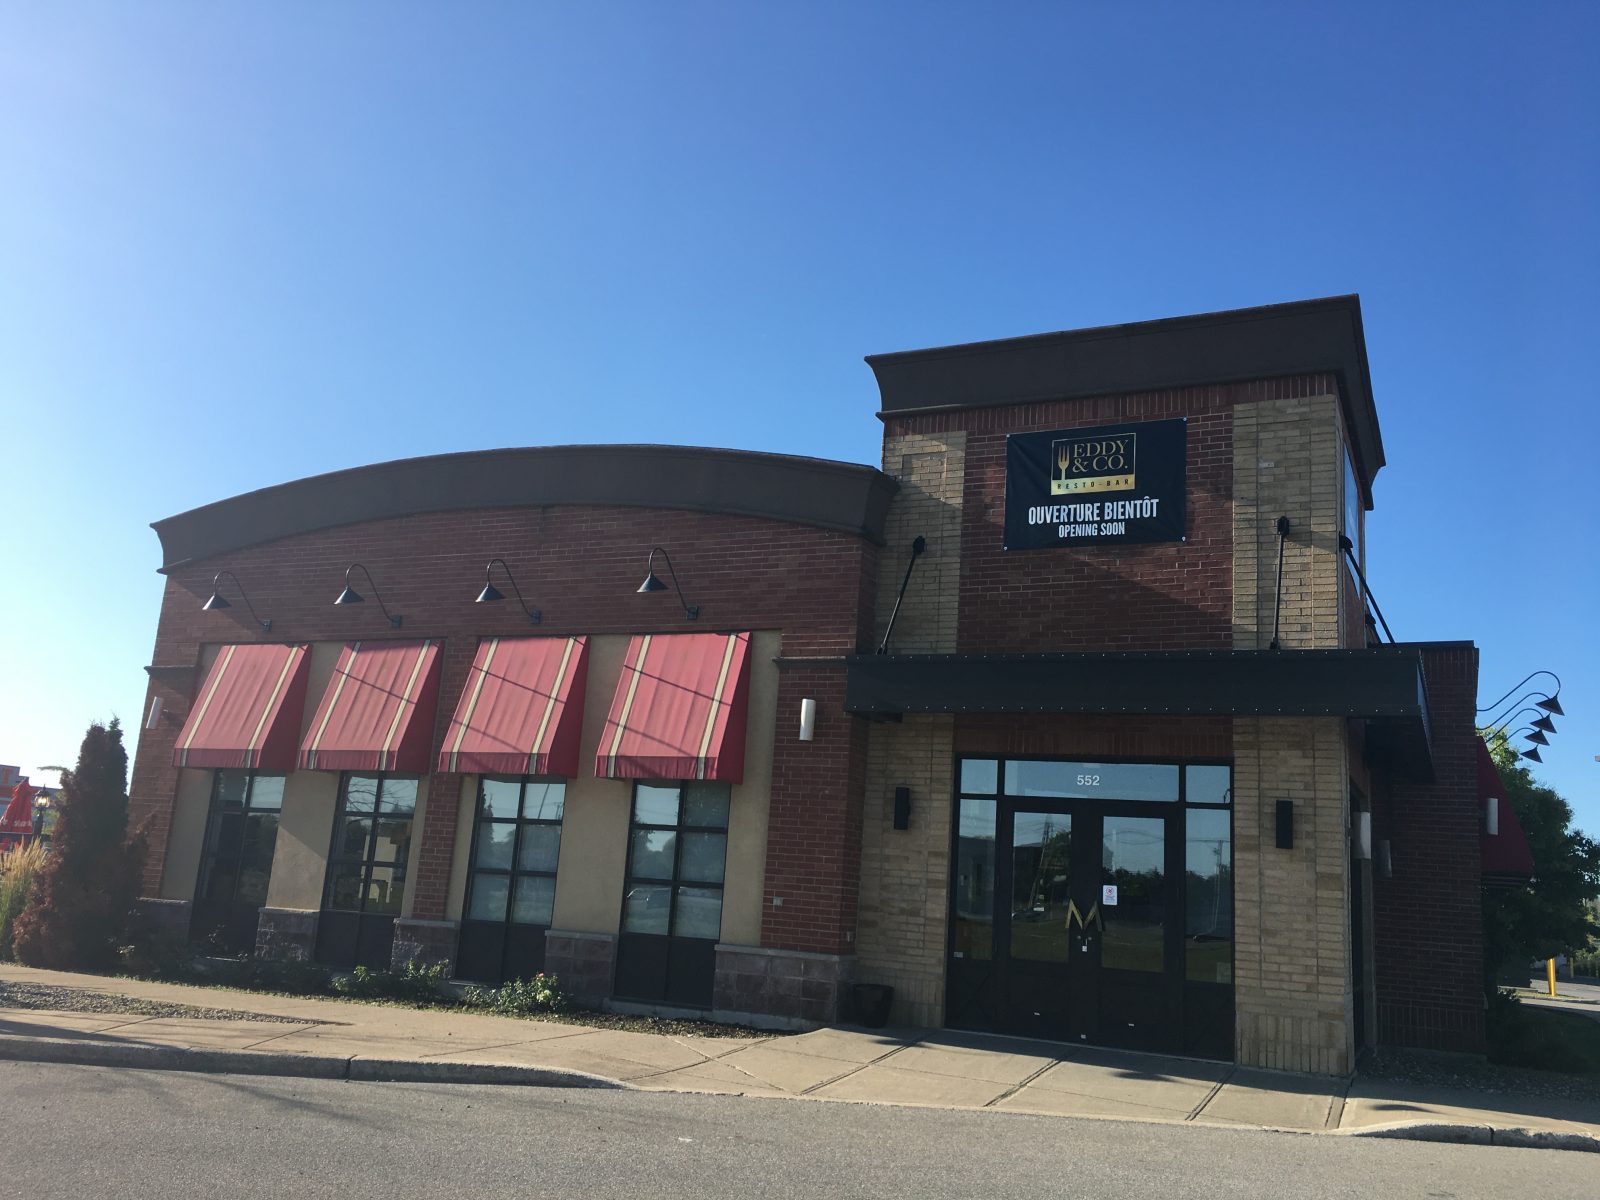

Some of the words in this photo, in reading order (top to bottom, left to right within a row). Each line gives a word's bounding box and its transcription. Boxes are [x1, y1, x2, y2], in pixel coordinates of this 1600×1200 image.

[1073, 440, 1128, 457] EDDY
[1072, 458, 1088, 473] &
[1092, 455, 1128, 471] CO.
[1028, 503, 1100, 525] OUVERTURE
[1104, 496, 1160, 519] BIENTÔT
[1058, 523, 1098, 538] OPENING
[1100, 521, 1126, 536] SOON
[1076, 774, 1100, 786] 552
